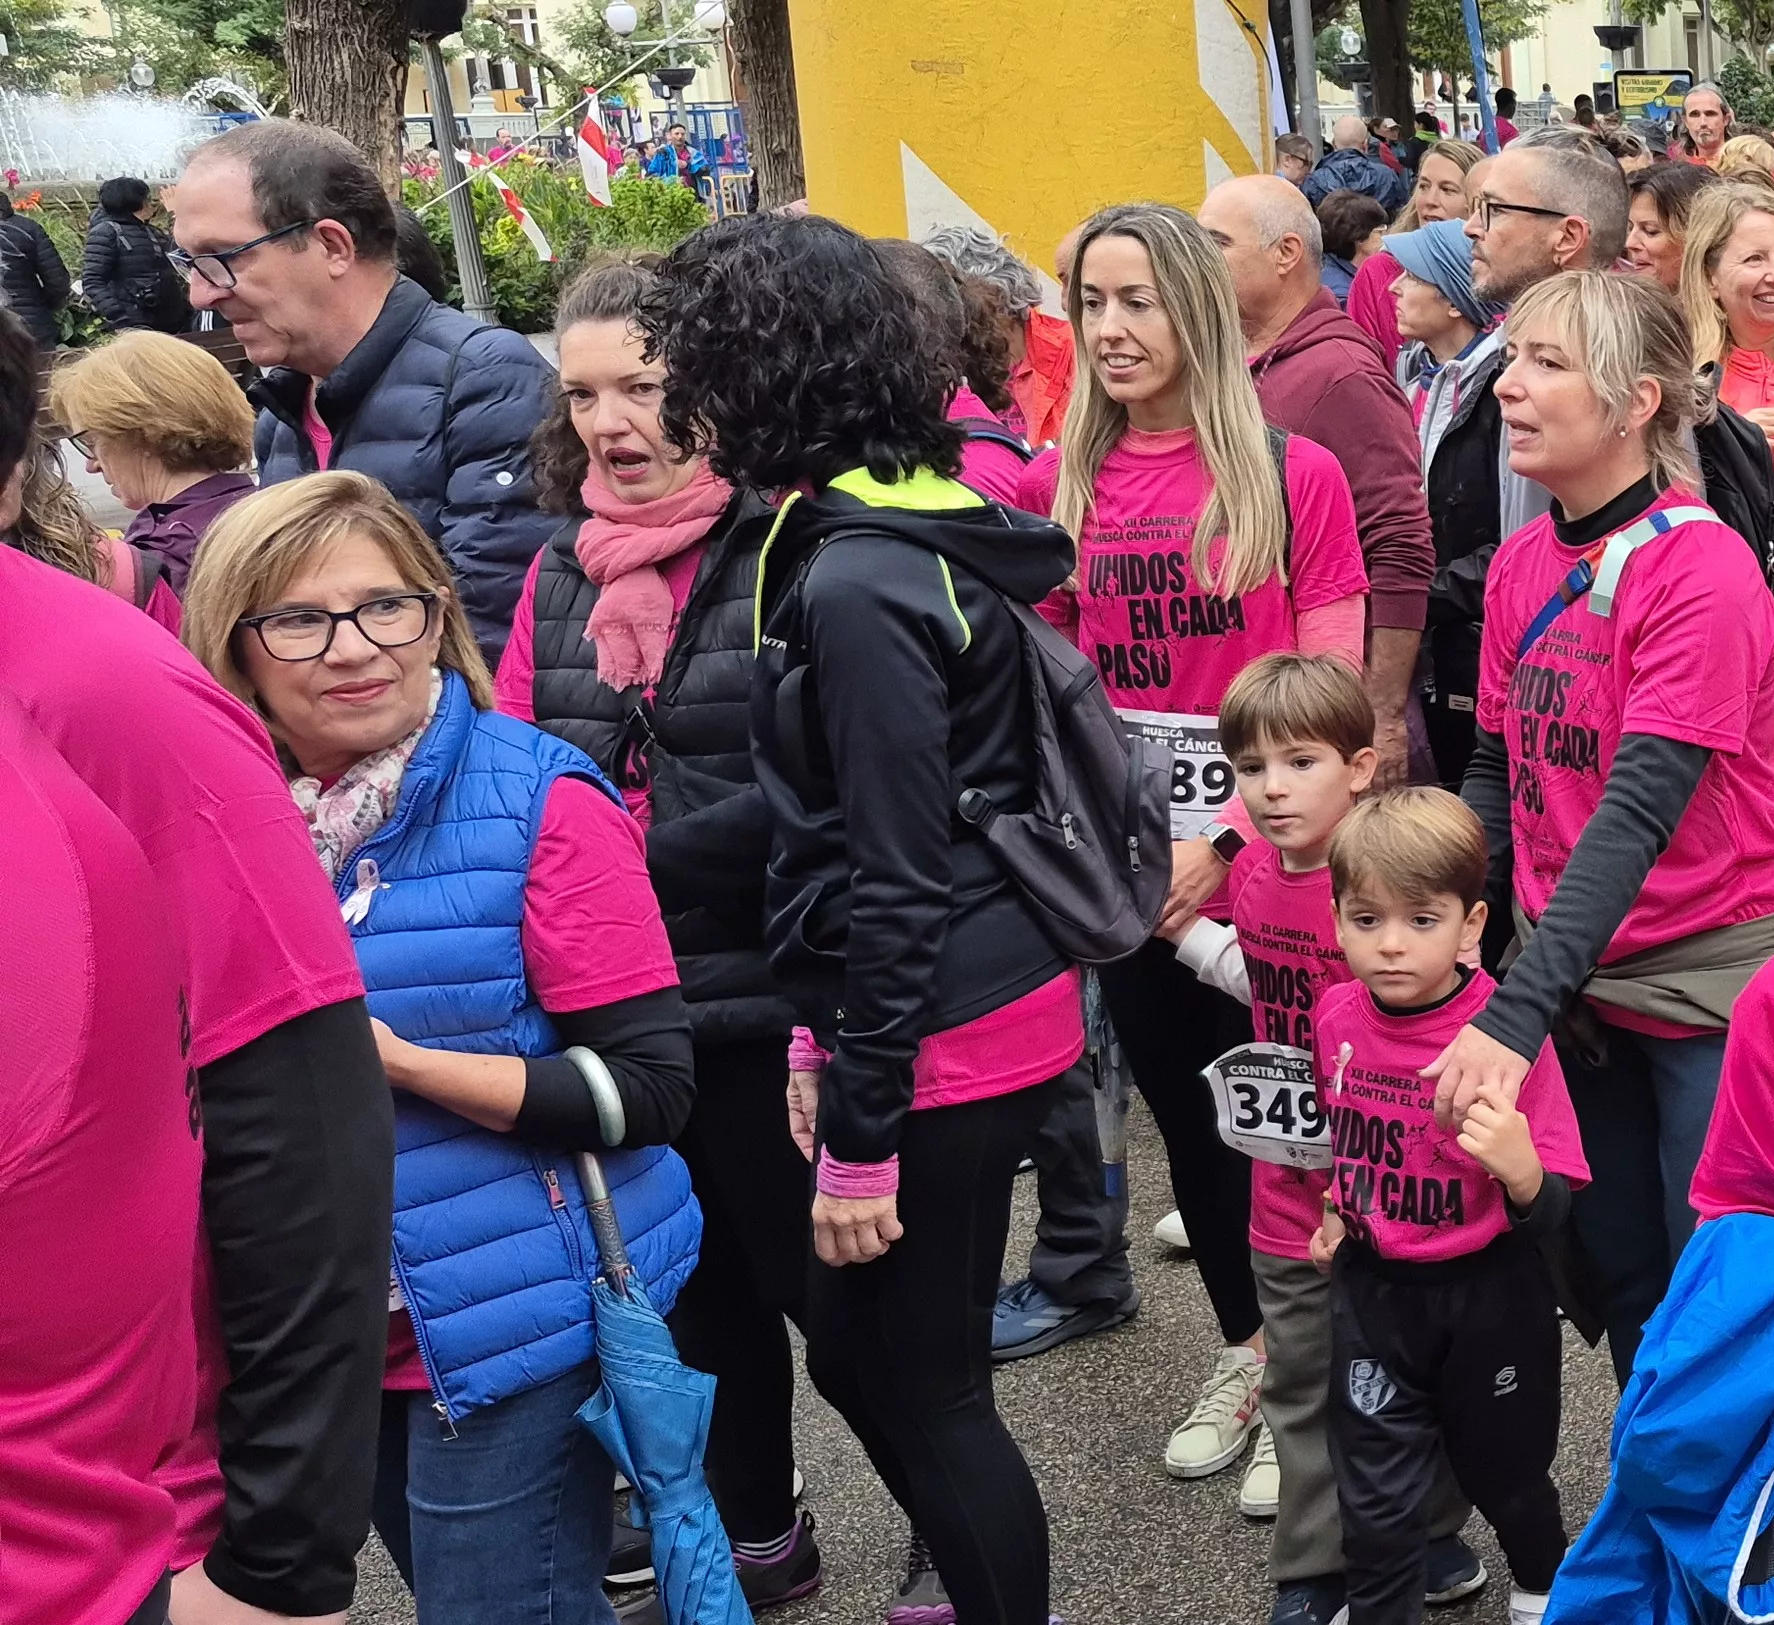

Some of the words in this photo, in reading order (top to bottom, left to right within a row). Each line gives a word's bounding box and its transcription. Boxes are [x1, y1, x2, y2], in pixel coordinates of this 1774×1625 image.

[1124, 517, 1137, 528] XII
[1140, 516, 1194, 528] CARRERA
[1126, 530, 1172, 541] CONTRA
[1174, 529, 1190, 539] EL
[1088, 551, 1187, 597] UNIDOS
[1128, 597, 1166, 641] EN
[1169, 595, 1246, 639] CADA
[1096, 641, 1173, 690] PASO
[1142, 725, 1184, 739] HUESCA
[1261, 922, 1272, 936] XII
[1272, 924, 1318, 944] CARRERA
[1263, 938, 1299, 955] CONTRA
[1300, 944, 1313, 957] EL
[1264, 1004, 1289, 1046] EN
[1229, 1064, 1286, 1080] CONTRA
[1288, 1070, 1303, 1081] EL
[1351, 1066, 1364, 1081] XII
[1365, 1070, 1422, 1093] CARRERA
[1351, 1083, 1397, 1104] CONTRA
[1400, 1094, 1414, 1107] EL
[1232, 1083, 1327, 1138] 349
[1338, 1162, 1376, 1216] EN
[1380, 1171, 1465, 1226] CADA
